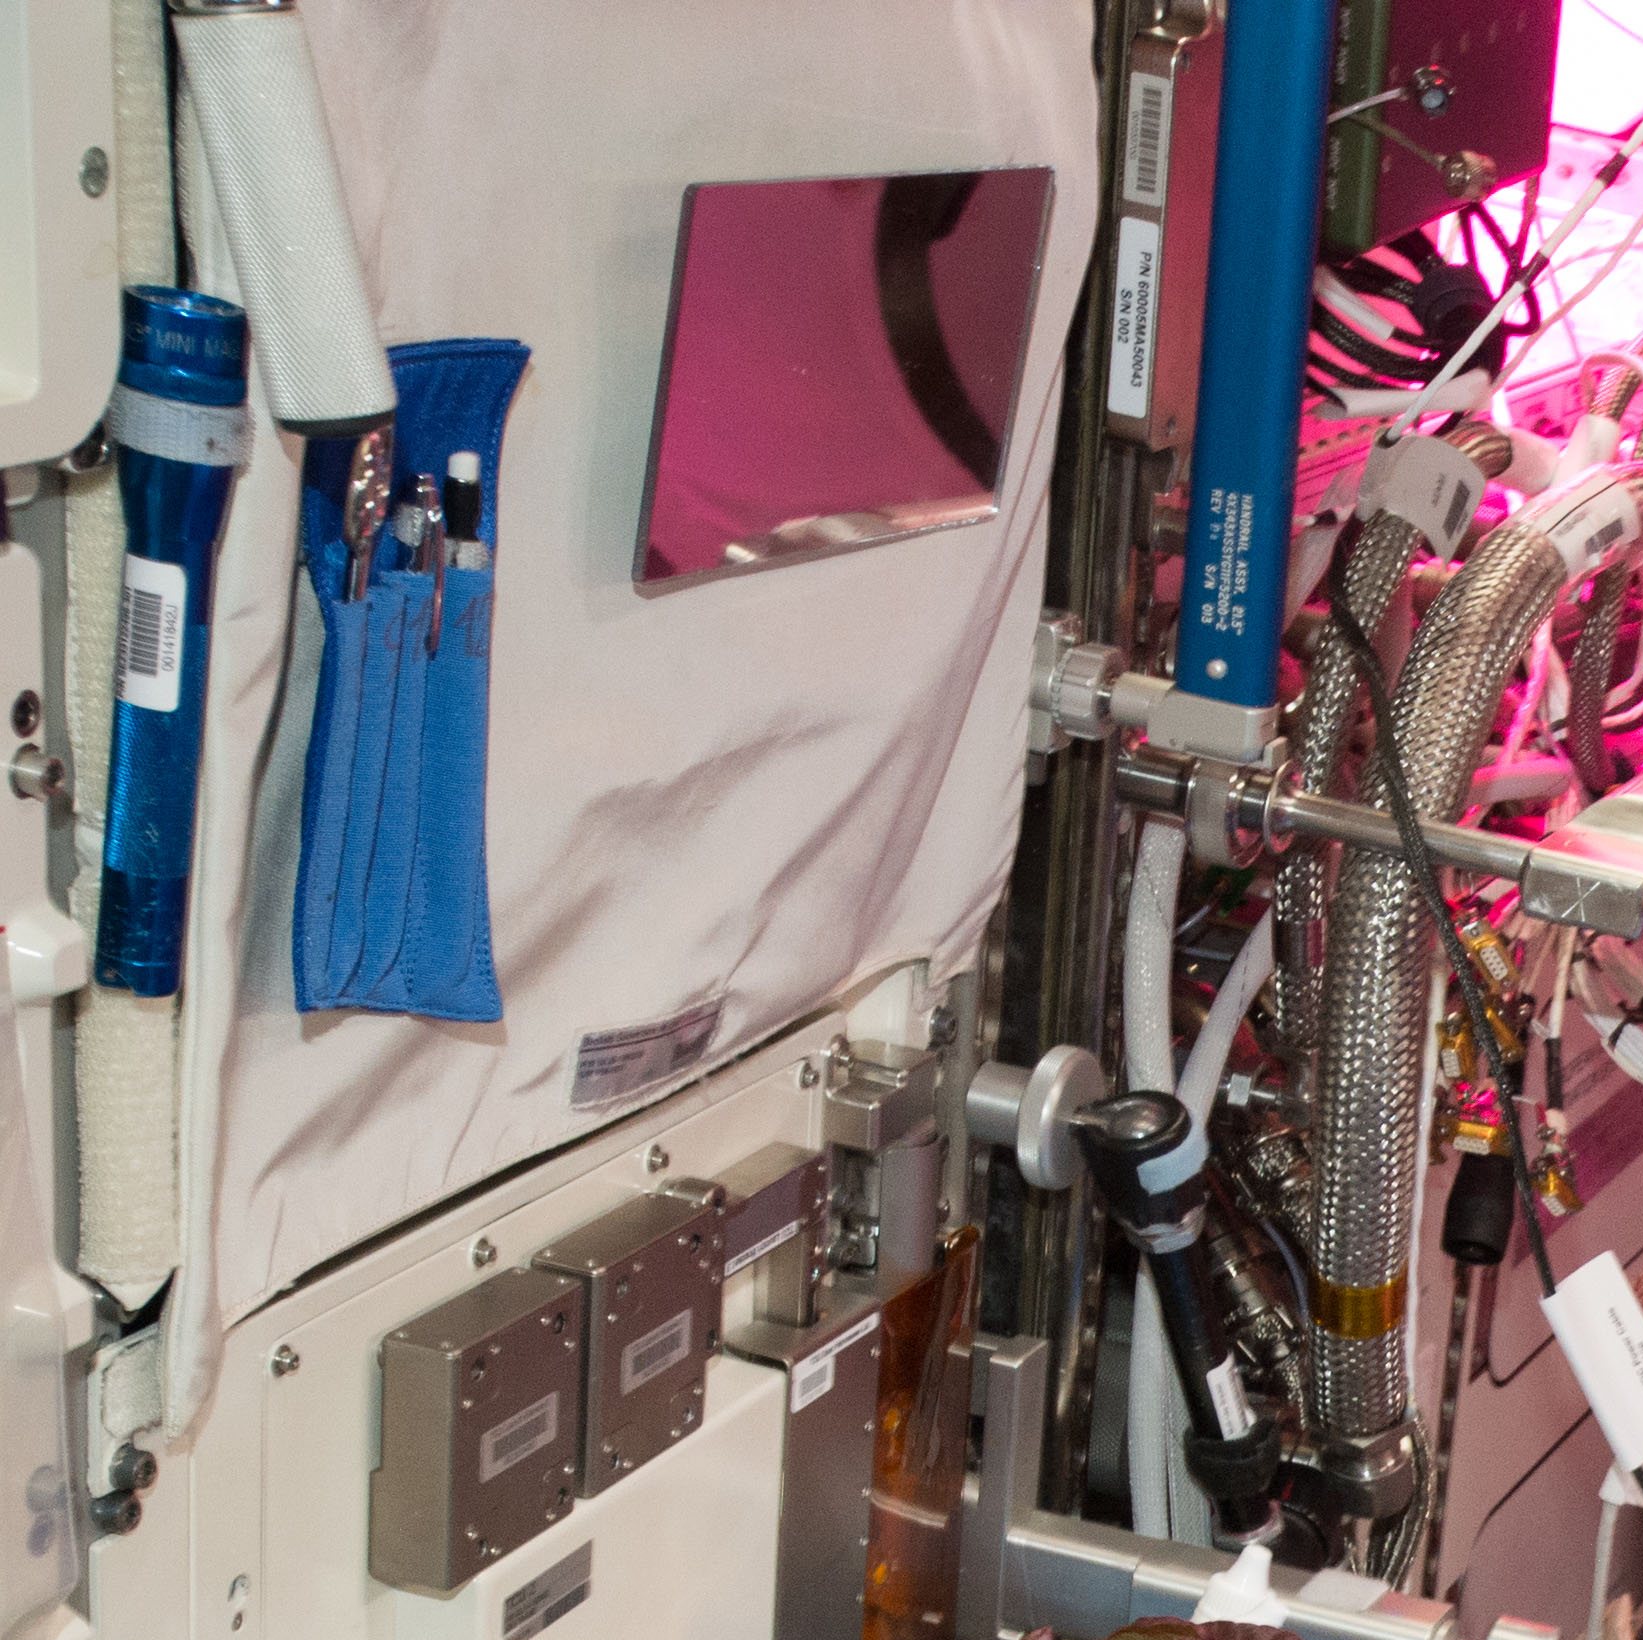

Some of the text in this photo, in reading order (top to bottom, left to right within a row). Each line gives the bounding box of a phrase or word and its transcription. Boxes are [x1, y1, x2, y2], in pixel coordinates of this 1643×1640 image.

[1117, 289, 1132, 344] S/N 002
[1131, 251, 1152, 388] P/N 60005MA50043
[155, 329, 195, 356] MINI
[1210, 489, 1221, 513] REV
[1237, 494, 1252, 552] HANDRAIL
[1203, 564, 1216, 590] S/N
[1233, 560, 1247, 594] ASSY.
[1201, 604, 1214, 623] 013
[162, 604, 179, 672] 00141842J
[1621, 1336, 1640, 1367] Power
